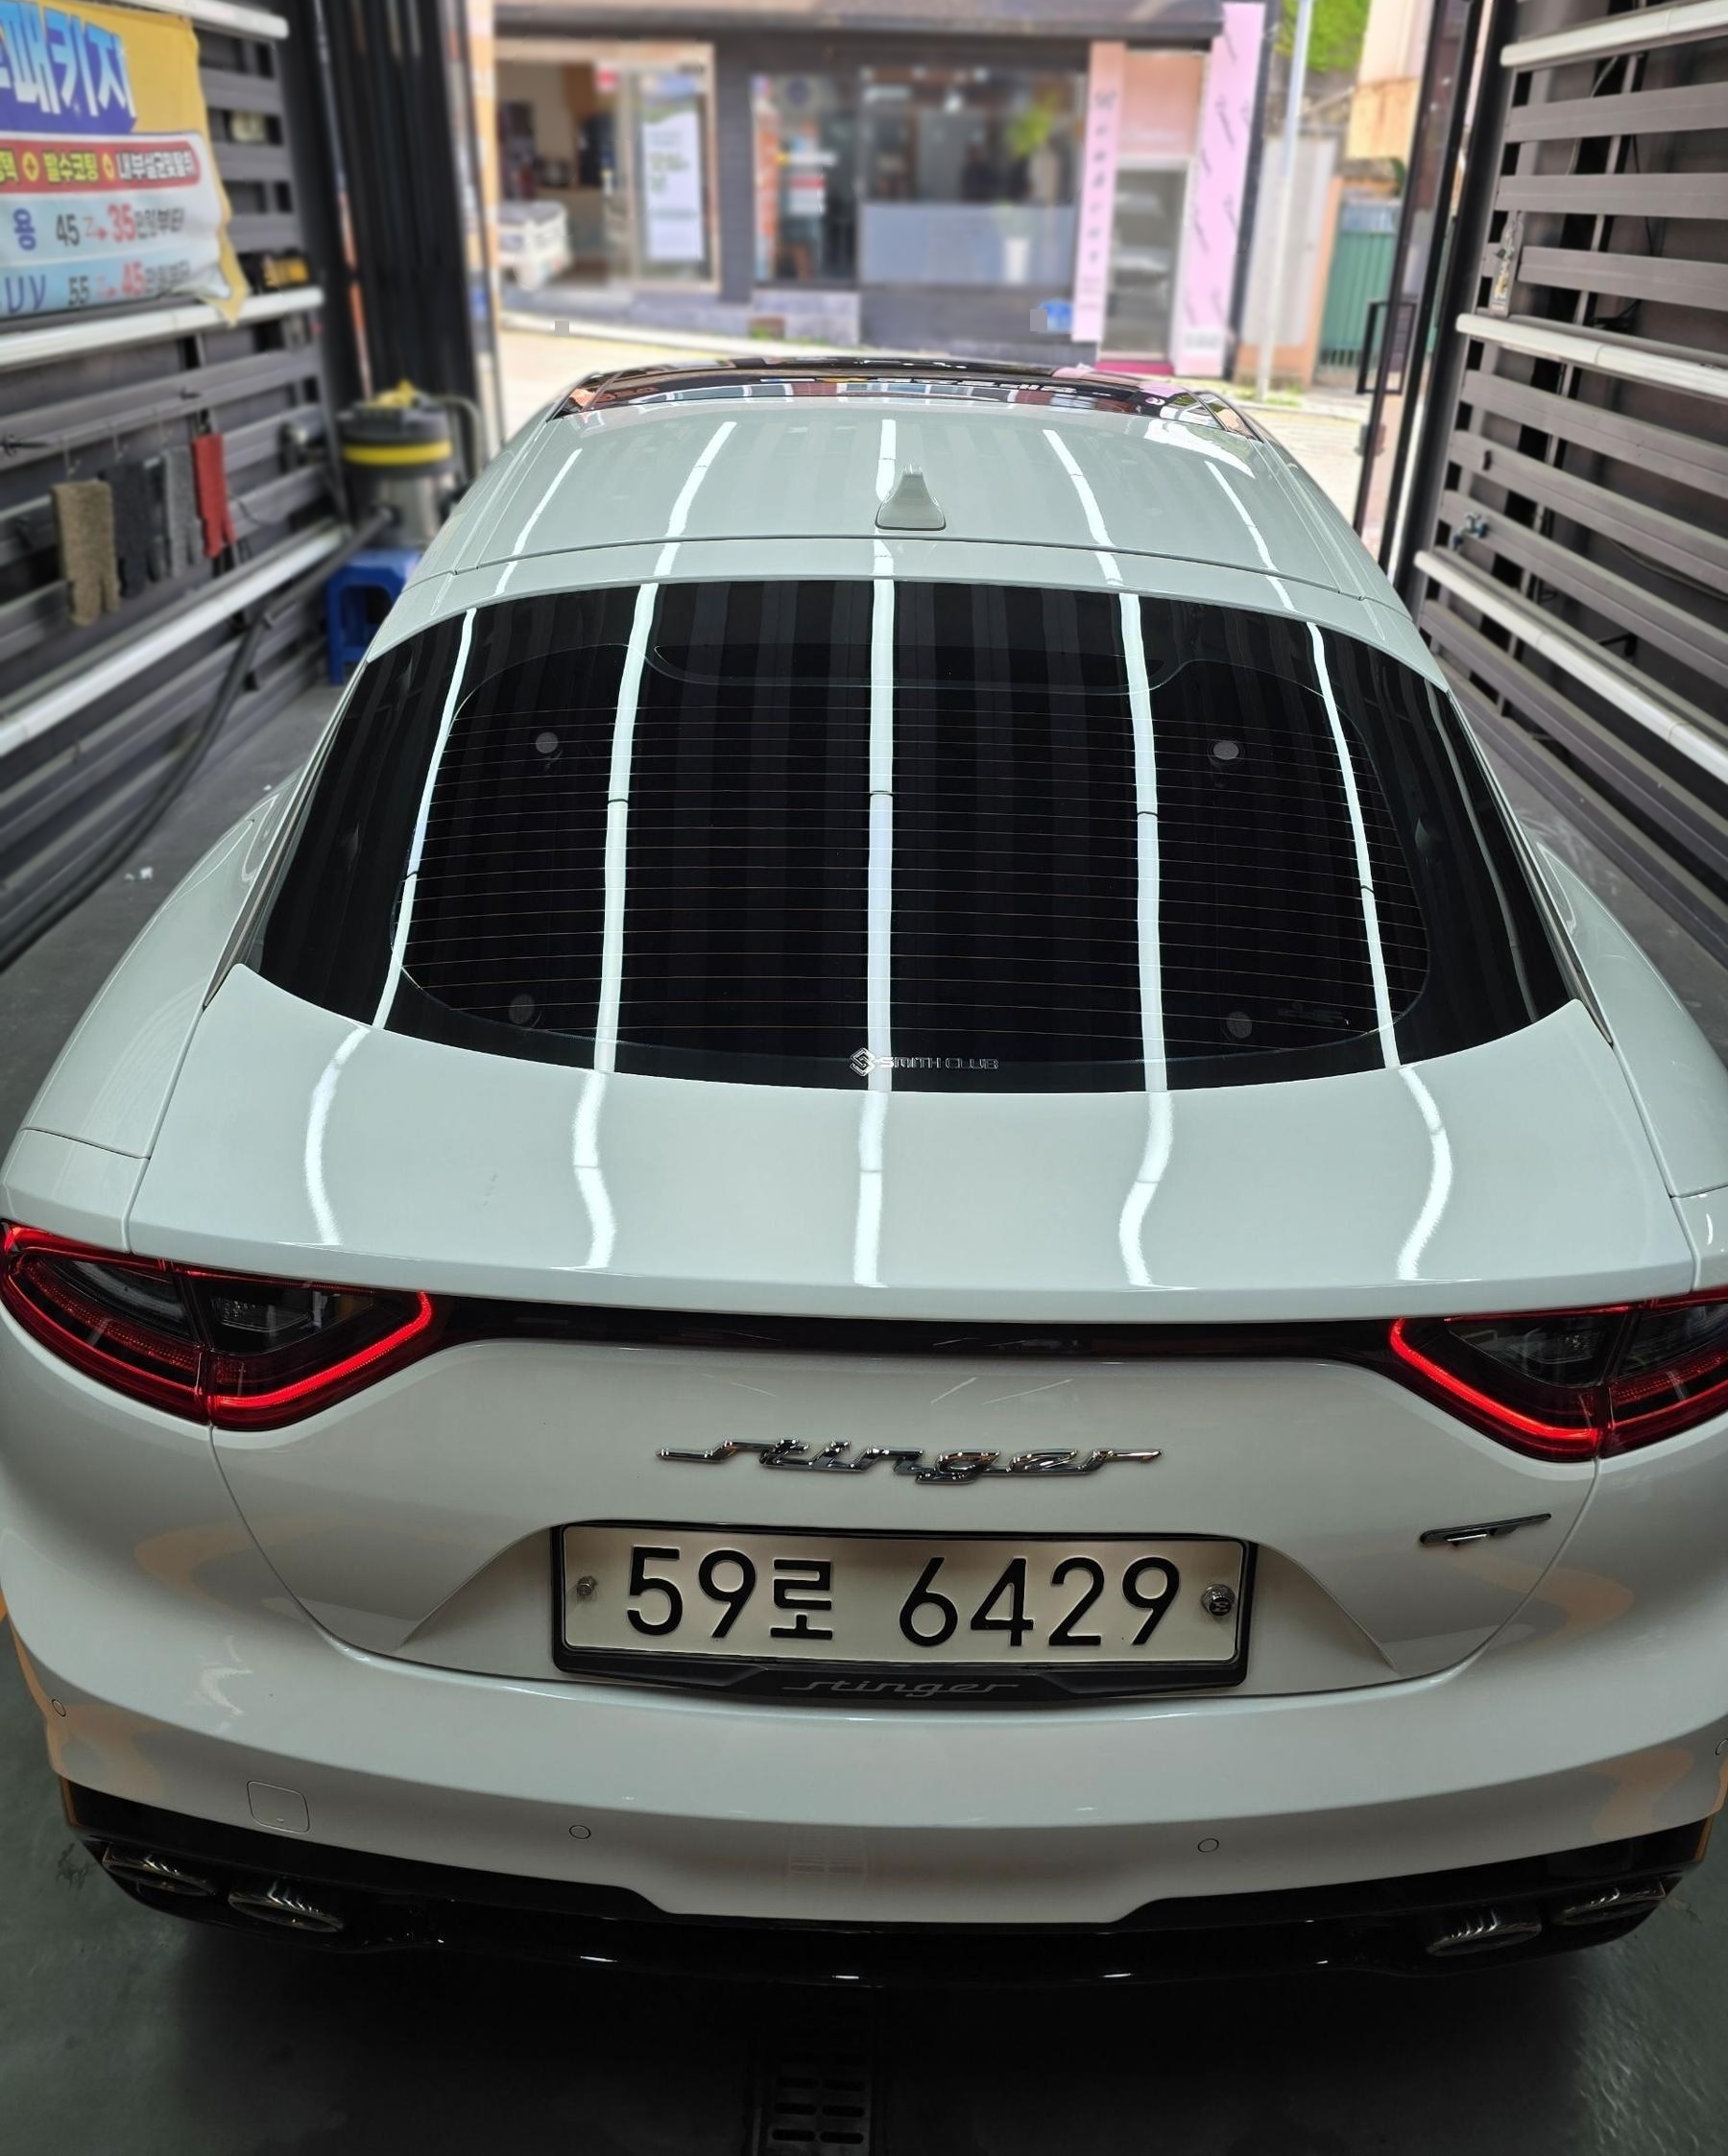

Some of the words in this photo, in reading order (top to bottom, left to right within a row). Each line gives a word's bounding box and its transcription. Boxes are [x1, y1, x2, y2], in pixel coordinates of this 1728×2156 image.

[0, 0, 136, 118] 패키지
[42, 151, 99, 182] 발수코팅
[13, 207, 36, 252] 용
[56, 214, 81, 247] 45
[68, 275, 90, 306] 55
[879, 1056, 942, 1069] SMITH
[946, 1057, 999, 1070] CLUB
[655, 1437, 1164, 1485] stinger
[625, 1545, 833, 1641] 59로
[898, 1555, 1180, 1647] 6429
[781, 1680, 1019, 1697] stinger
